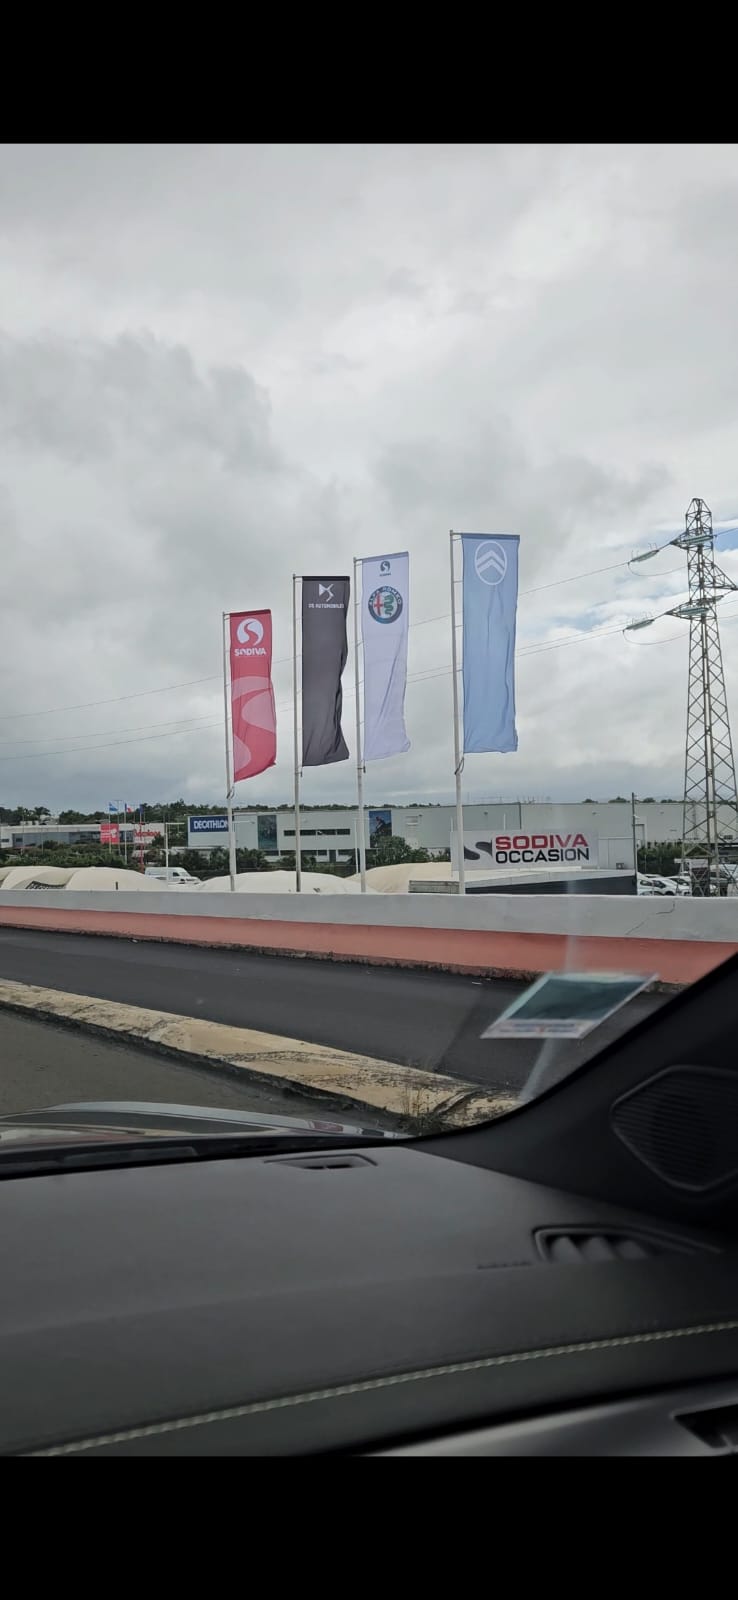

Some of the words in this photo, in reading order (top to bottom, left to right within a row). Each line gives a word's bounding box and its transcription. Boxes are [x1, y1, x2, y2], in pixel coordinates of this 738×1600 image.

[234, 647, 267, 657] SODIVA
[495, 834, 588, 850] SODIVA
[495, 848, 590, 864] OCCASION
